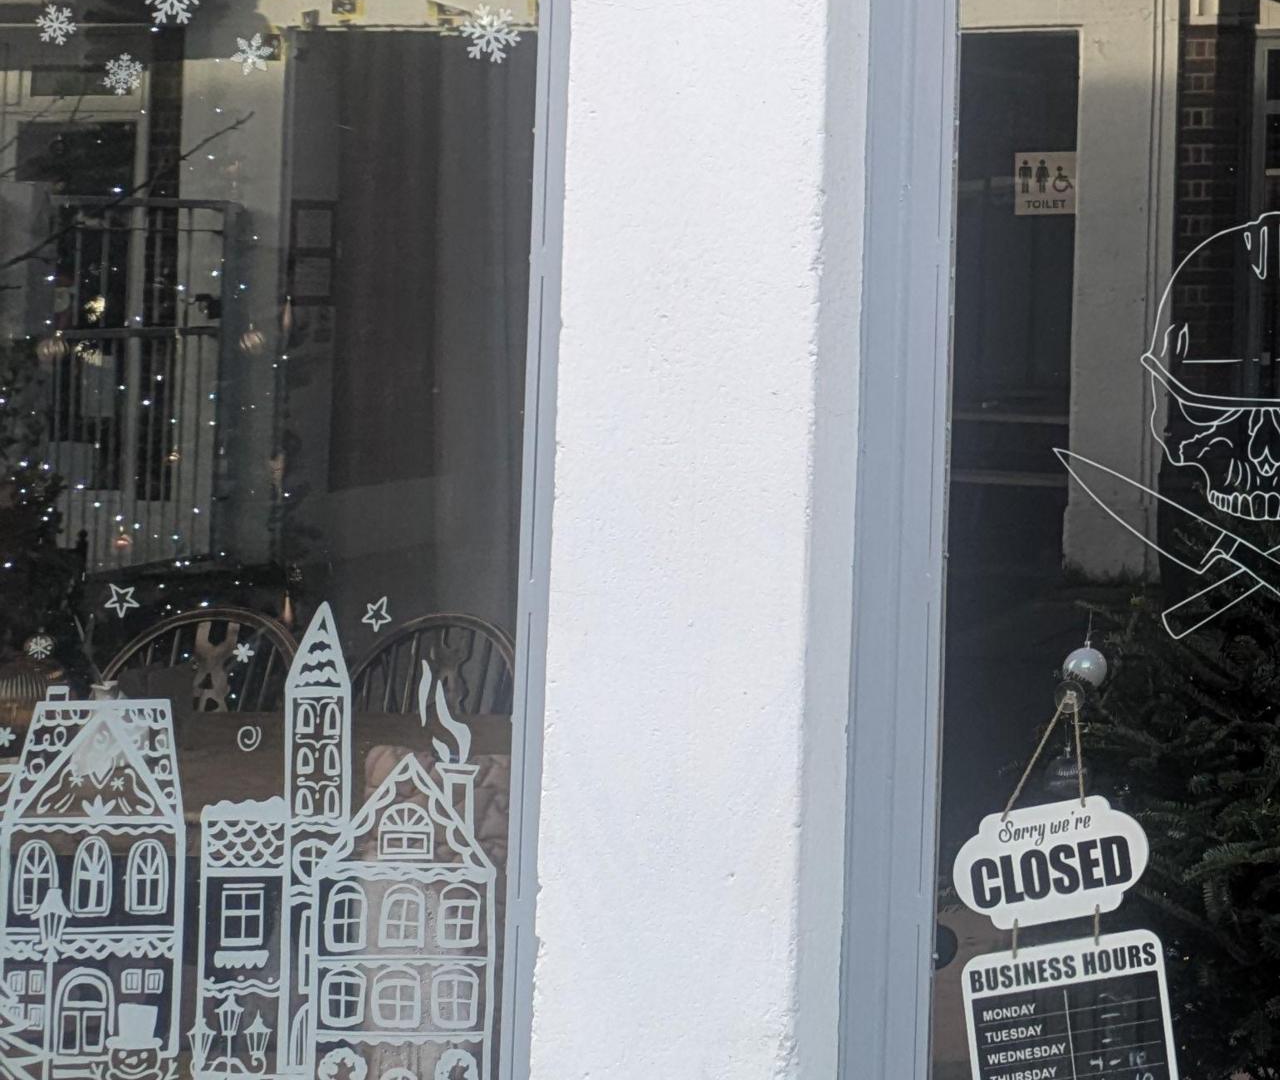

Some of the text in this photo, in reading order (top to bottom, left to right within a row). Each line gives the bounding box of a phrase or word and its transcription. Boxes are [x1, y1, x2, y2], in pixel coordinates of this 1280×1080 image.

[1025, 200, 1066, 209] TOILET
[999, 811, 1091, 846] Sorry we're
[970, 835, 1133, 909] CLOSED
[969, 942, 1157, 994] BUSINESS HOURS
[983, 1003, 1036, 1022] MONDAY
[985, 1024, 1043, 1043] TUESDAY
[987, 1042, 1066, 1065] WEDNESDAY
